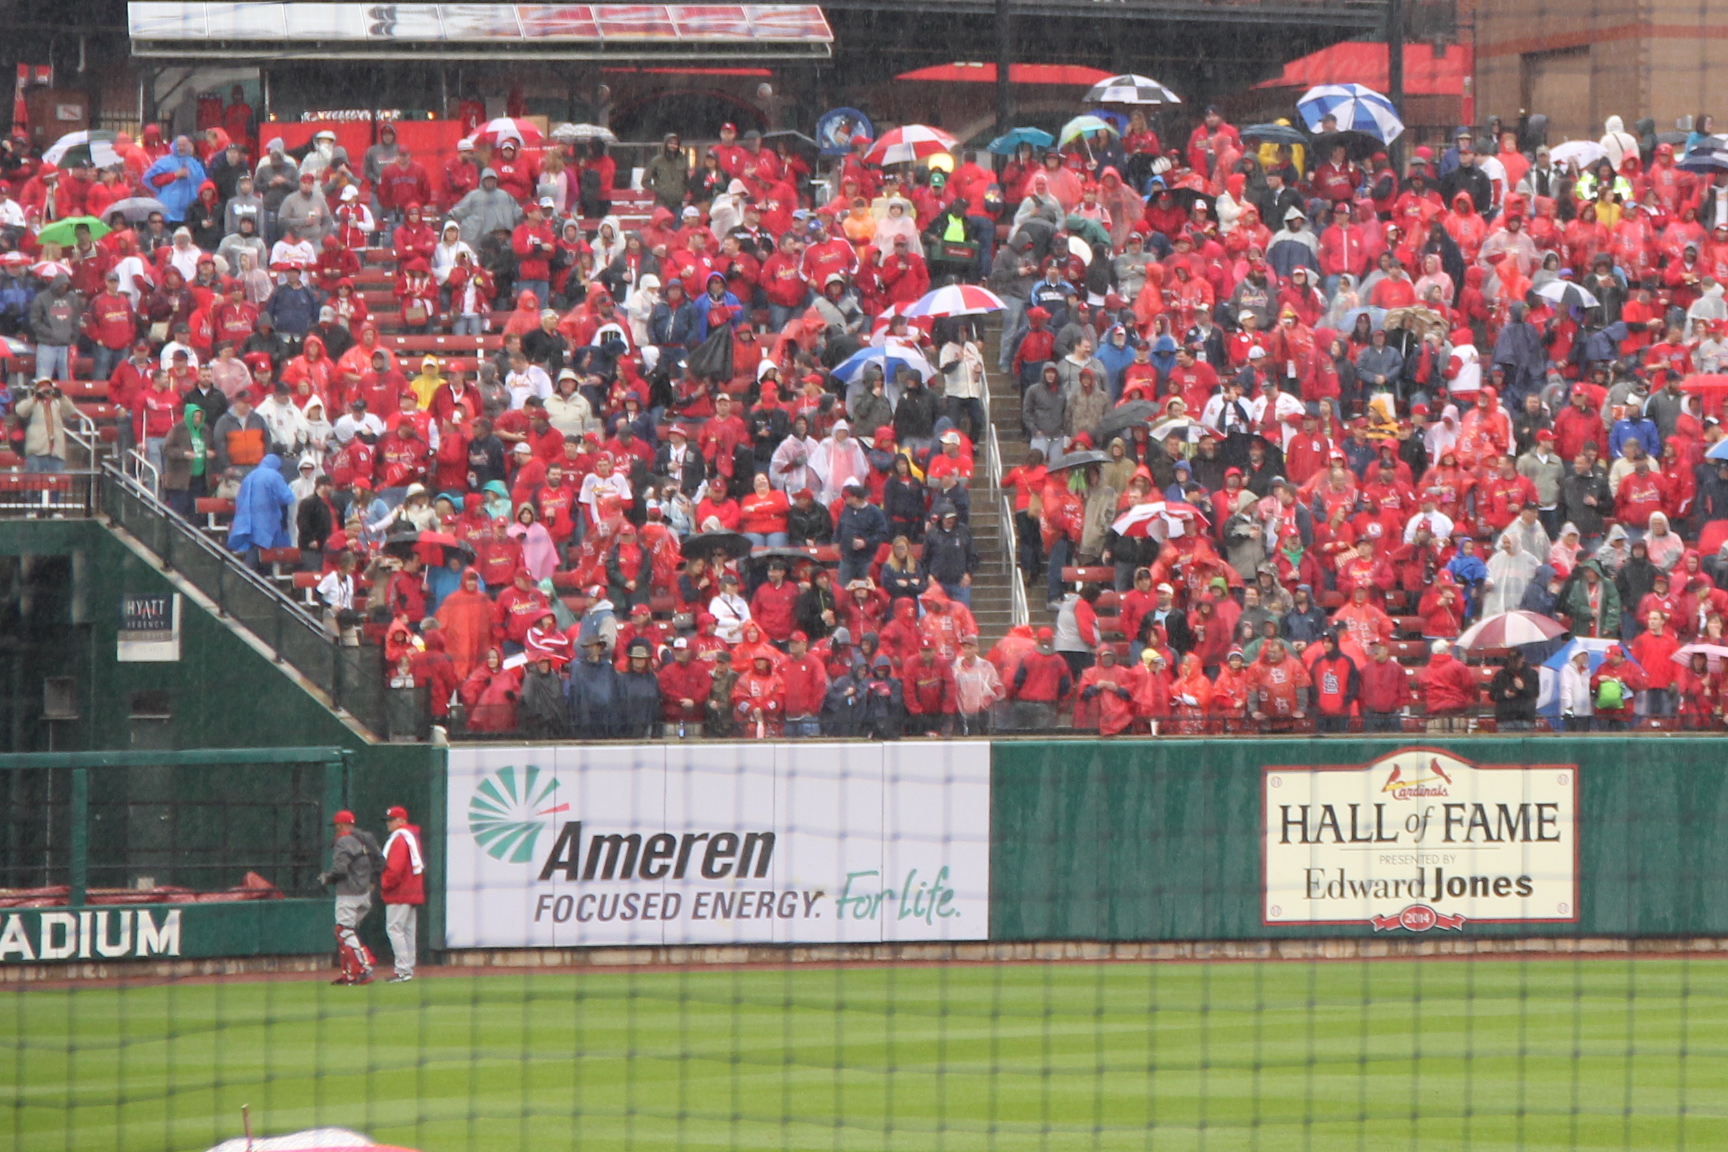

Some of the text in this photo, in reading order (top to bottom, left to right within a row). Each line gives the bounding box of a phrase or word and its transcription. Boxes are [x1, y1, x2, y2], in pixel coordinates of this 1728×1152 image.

[127, 600, 165, 619] HYATT
[1391, 784, 1450, 801] Cardinals
[1279, 802, 1562, 845] HALL of FAME
[538, 820, 777, 881] Ameren
[1379, 854, 1457, 865] PRESENTED BY
[836, 865, 962, 926] For Life.
[1303, 867, 1534, 903] Edward Jones
[534, 891, 822, 923] FOCUSED ENERGY.
[1405, 913, 1431, 924] 2014
